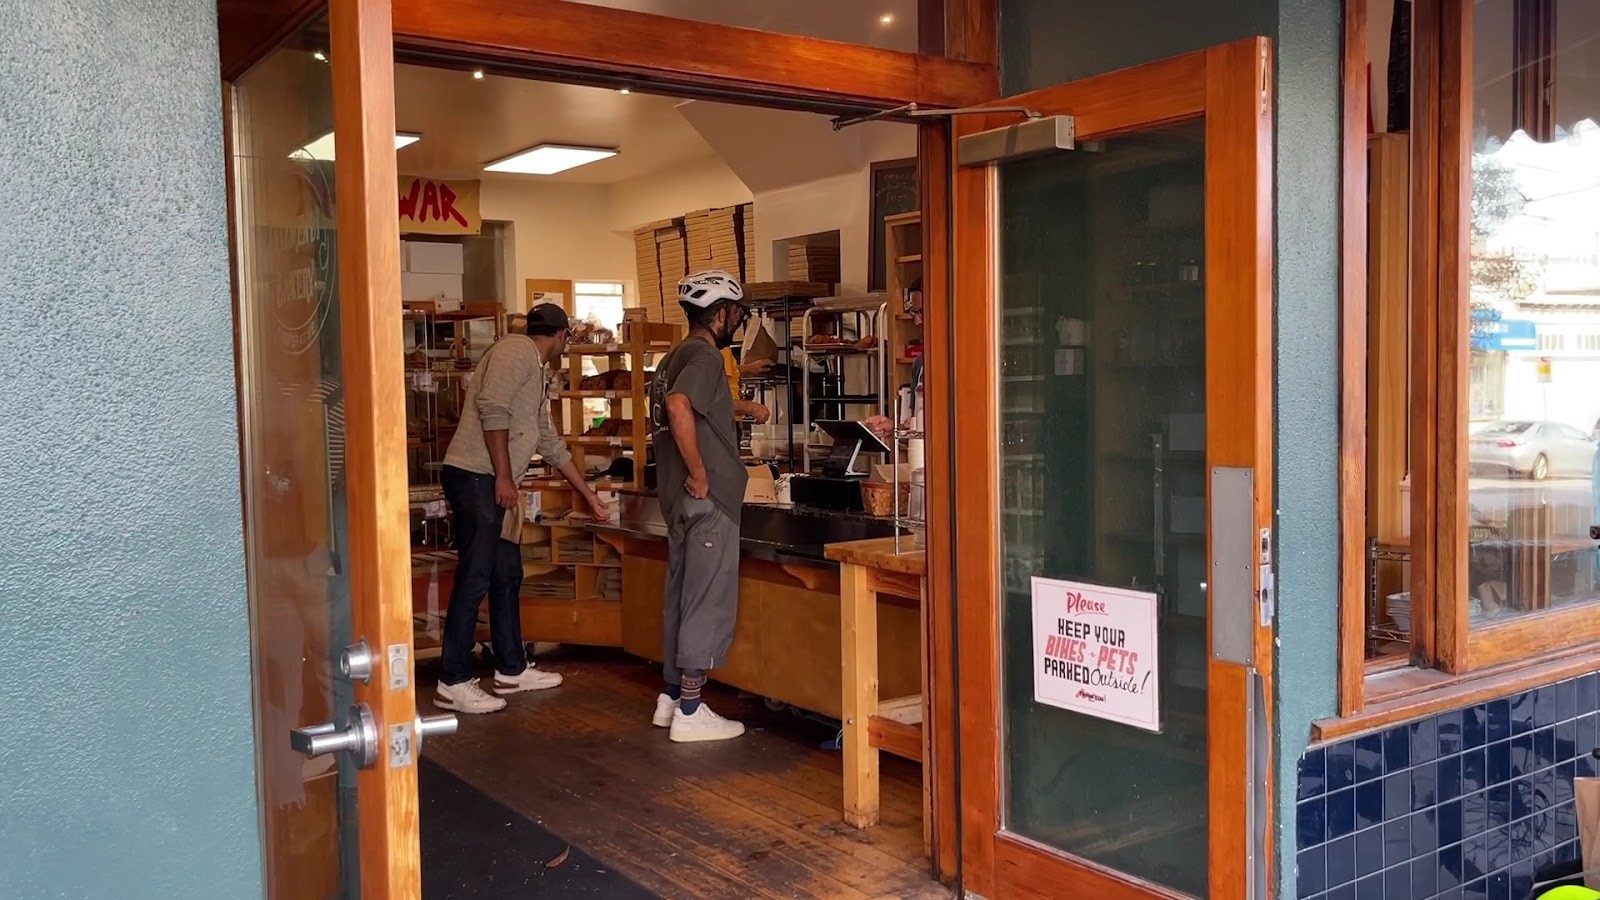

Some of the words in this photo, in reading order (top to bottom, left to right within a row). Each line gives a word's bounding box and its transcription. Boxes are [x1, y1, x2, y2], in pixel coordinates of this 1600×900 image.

[1066, 591, 1106, 614] Please
[1058, 618, 1091, 640] KEEP
[1094, 625, 1126, 648] YOUR
[1044, 634, 1087, 663] BIKES
[1097, 645, 1138, 675] PETS
[1044, 657, 1090, 685] PARKED
[1090, 668, 1151, 694] Outside!
